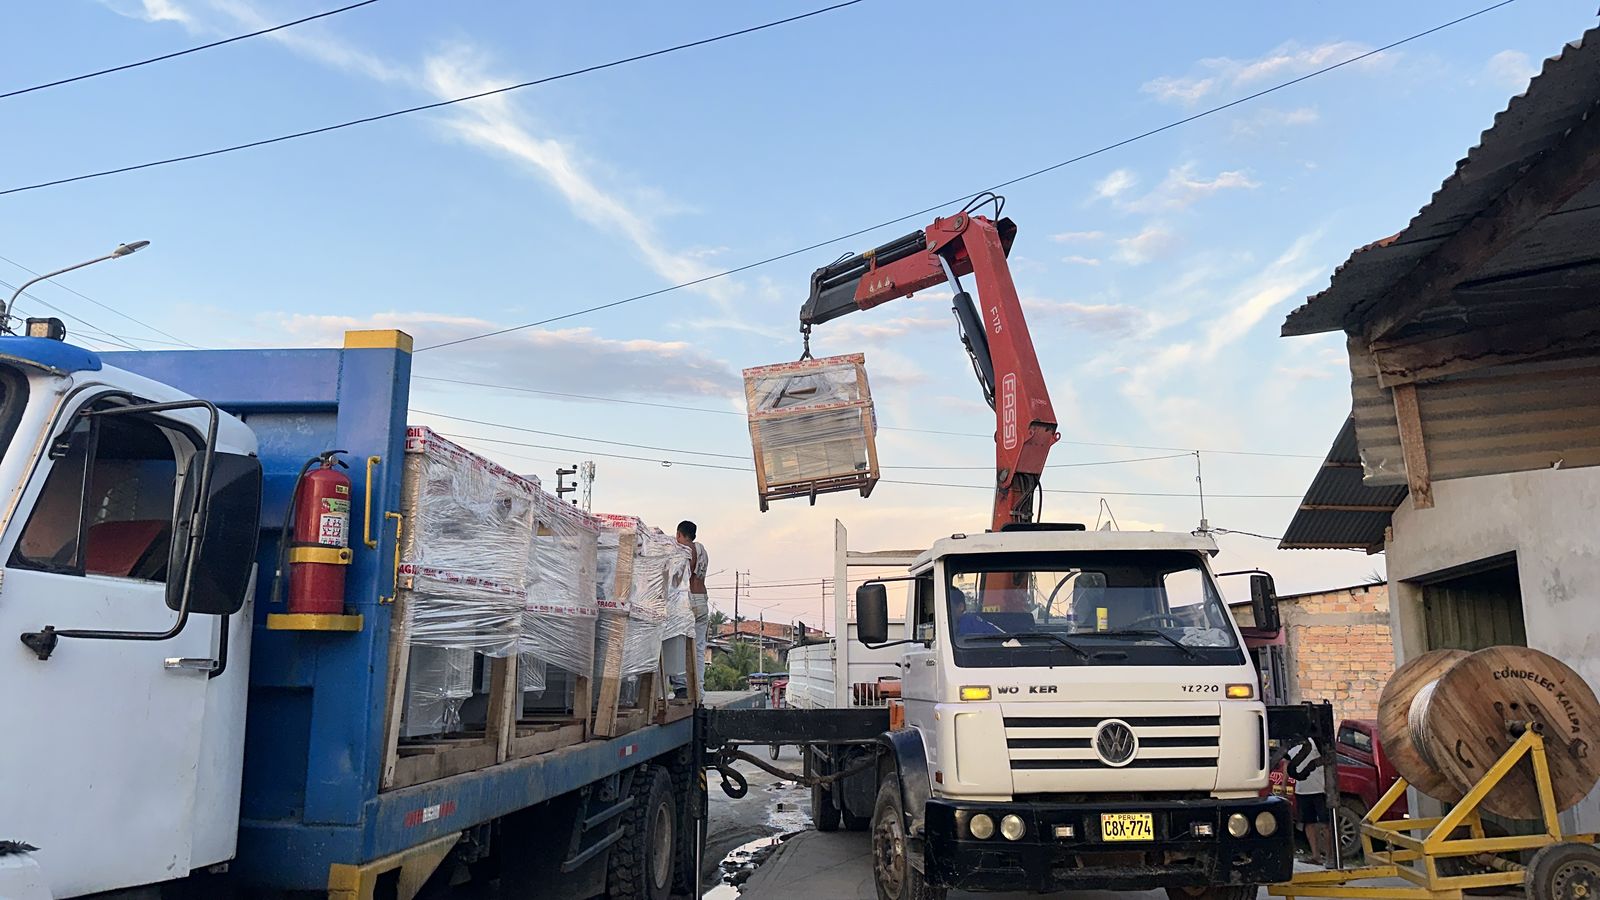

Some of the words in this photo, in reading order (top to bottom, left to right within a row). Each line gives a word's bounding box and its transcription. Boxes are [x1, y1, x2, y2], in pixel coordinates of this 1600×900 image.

[990, 306, 1002, 334] F175
[1004, 379, 1015, 445] FASSI
[1493, 667, 1555, 691] CONDELEC
[1556, 691, 1580, 733] KALLPA
[1104, 820, 1151, 836] C8X-774
